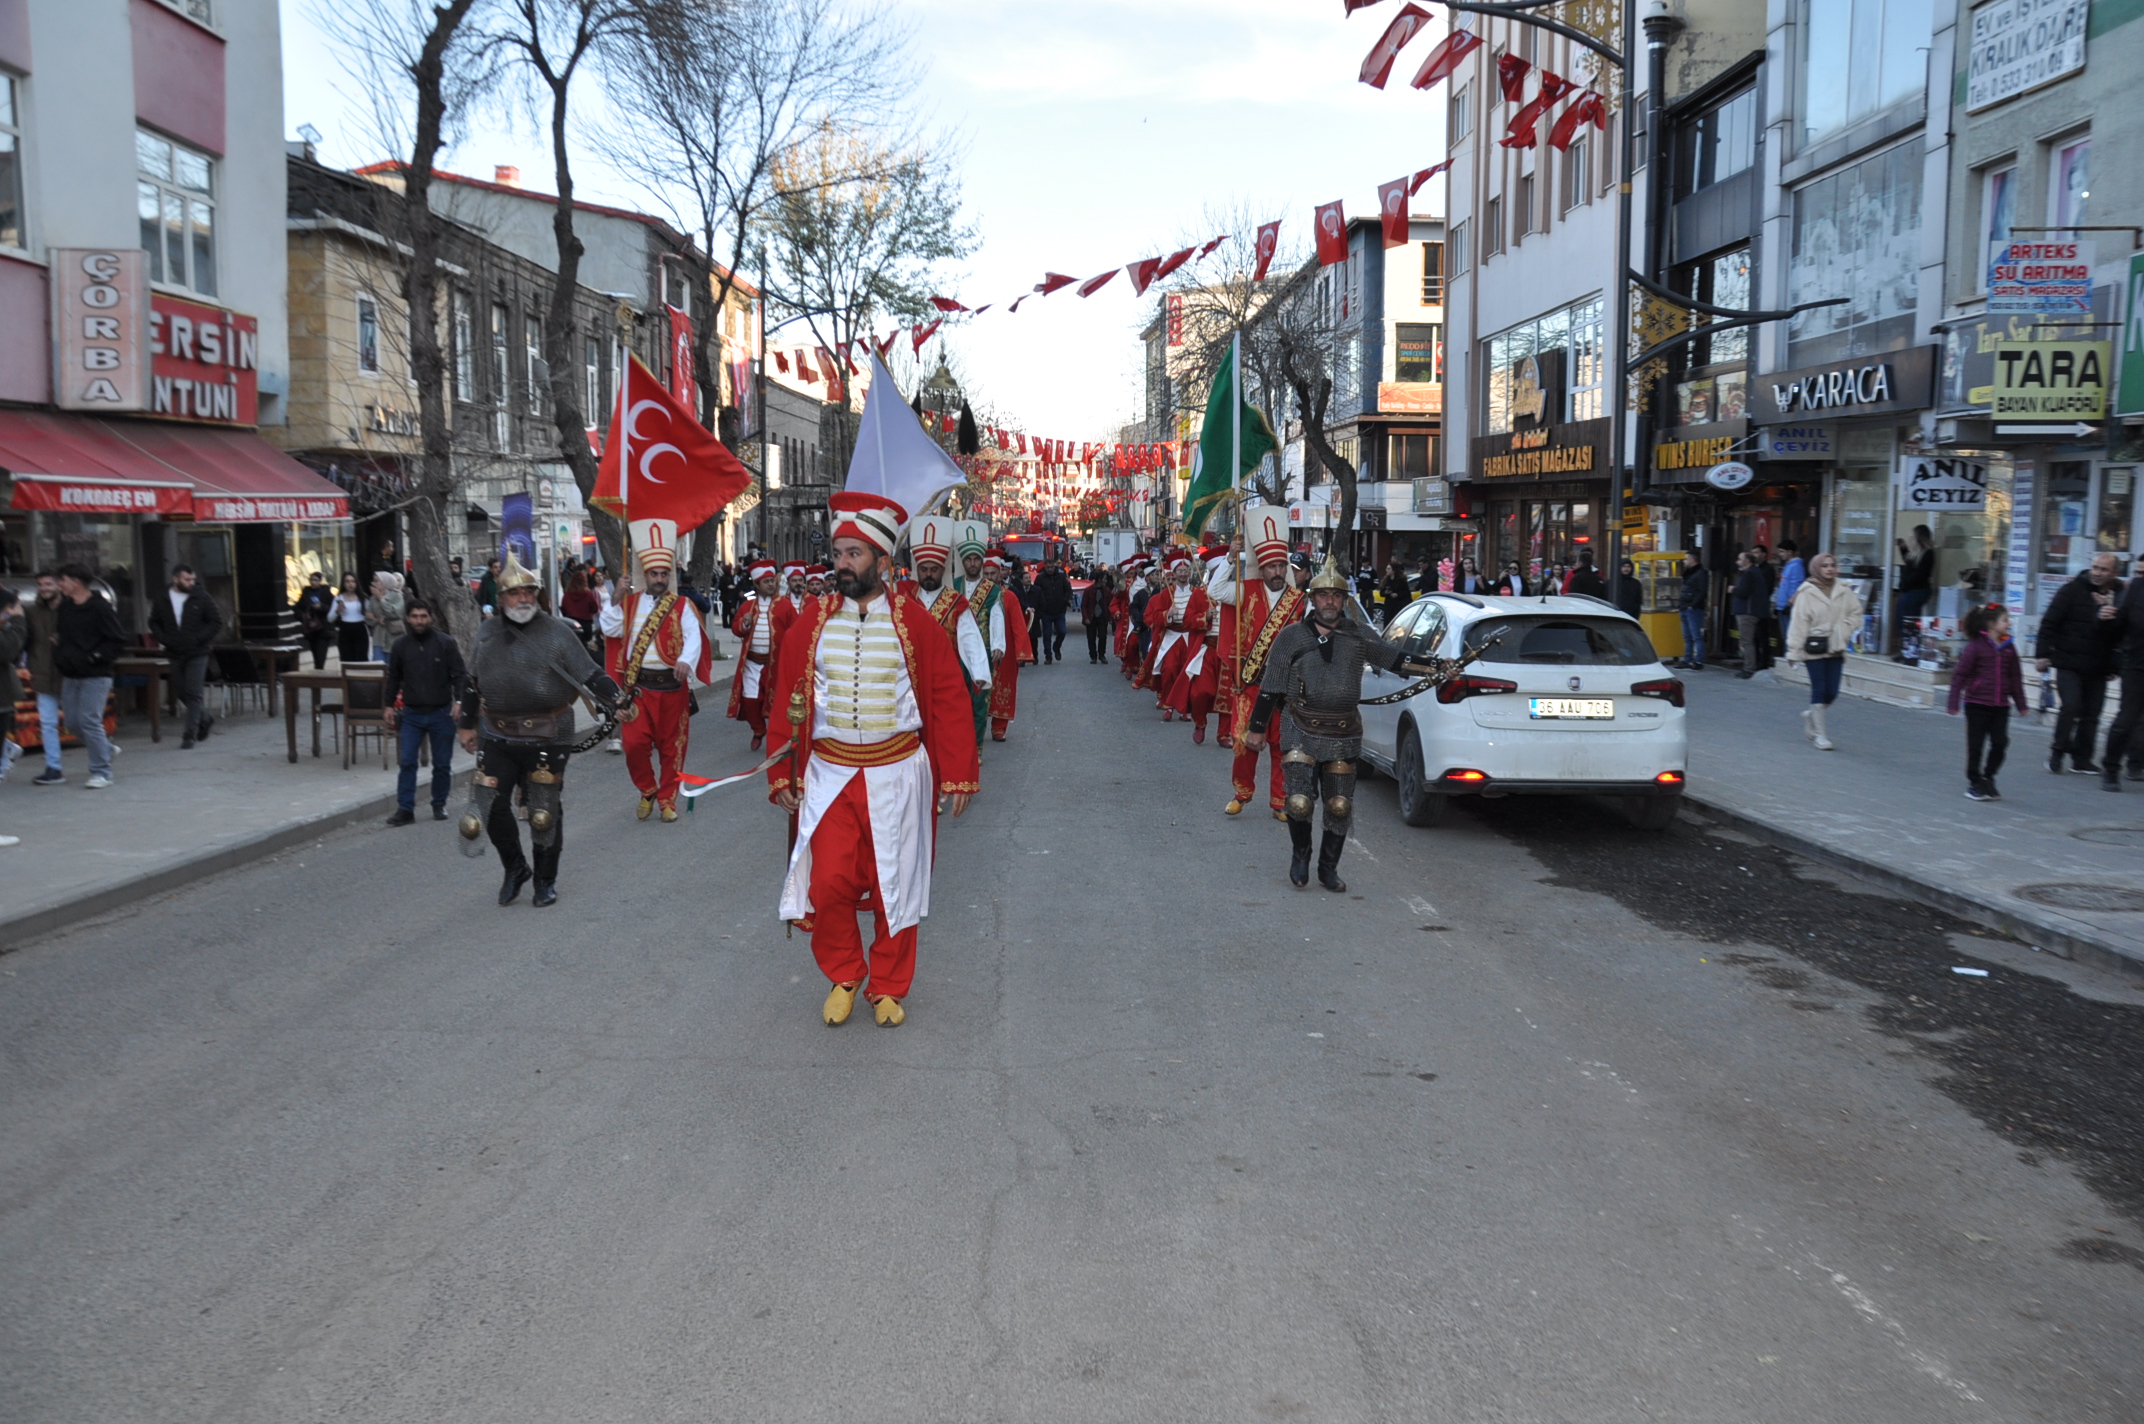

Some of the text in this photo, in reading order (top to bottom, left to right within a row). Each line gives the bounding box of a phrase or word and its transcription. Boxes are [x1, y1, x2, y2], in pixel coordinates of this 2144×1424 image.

[2009, 244, 2077, 260] ARTEKS
[1993, 265, 2088, 281] SU ARITMA
[1993, 286, 2026, 298] SATIŞ
[81, 252, 121, 402] ÇORBA
[150, 310, 257, 371] ERSİN
[1998, 350, 2104, 388] TARA
[153, 371, 237, 420] NTUNİ
[1800, 364, 1889, 411] KARACA
[1997, 396, 2038, 413] BAYAN
[1778, 428, 1828, 439] ANIL
[1773, 439, 1831, 456] ÇEYİZ
[1483, 444, 1593, 480] FABRİKA SATIŞ MAĞAZASI
[1910, 458, 1987, 488] ANIL
[1912, 486, 1982, 507] ÇEYİZ
[1539, 702, 1610, 714] 36 AAU 706
